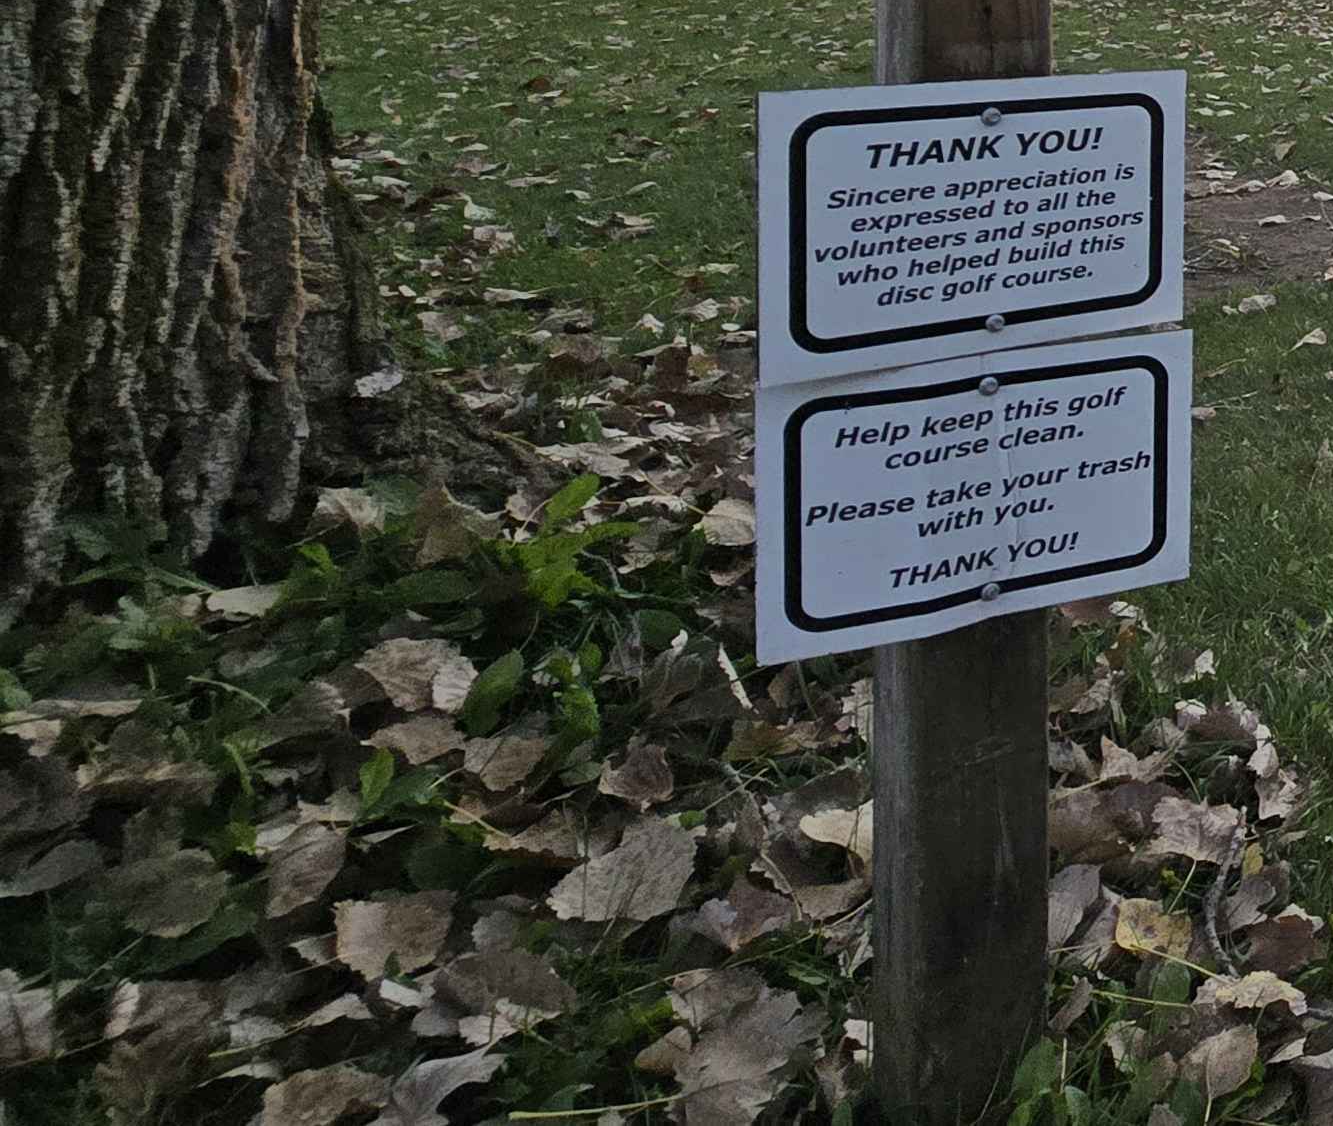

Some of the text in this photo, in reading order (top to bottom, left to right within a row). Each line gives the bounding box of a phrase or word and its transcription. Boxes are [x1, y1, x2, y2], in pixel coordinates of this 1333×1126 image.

[866, 127, 1104, 169] THANK YOU!
[827, 163, 1135, 209] Sincere appreciation is
[850, 189, 1116, 234] expressed to all the
[814, 211, 1144, 263] volunteers and sponsors
[837, 234, 1125, 286] who helped build this
[877, 267, 1094, 306] disc golf course.
[835, 386, 1128, 448] Help keep this golf
[885, 423, 1084, 470] course clean.
[805, 451, 1151, 527] Please take your trash
[917, 496, 1055, 538] with you.
[890, 532, 1080, 588] THANK YOU!
